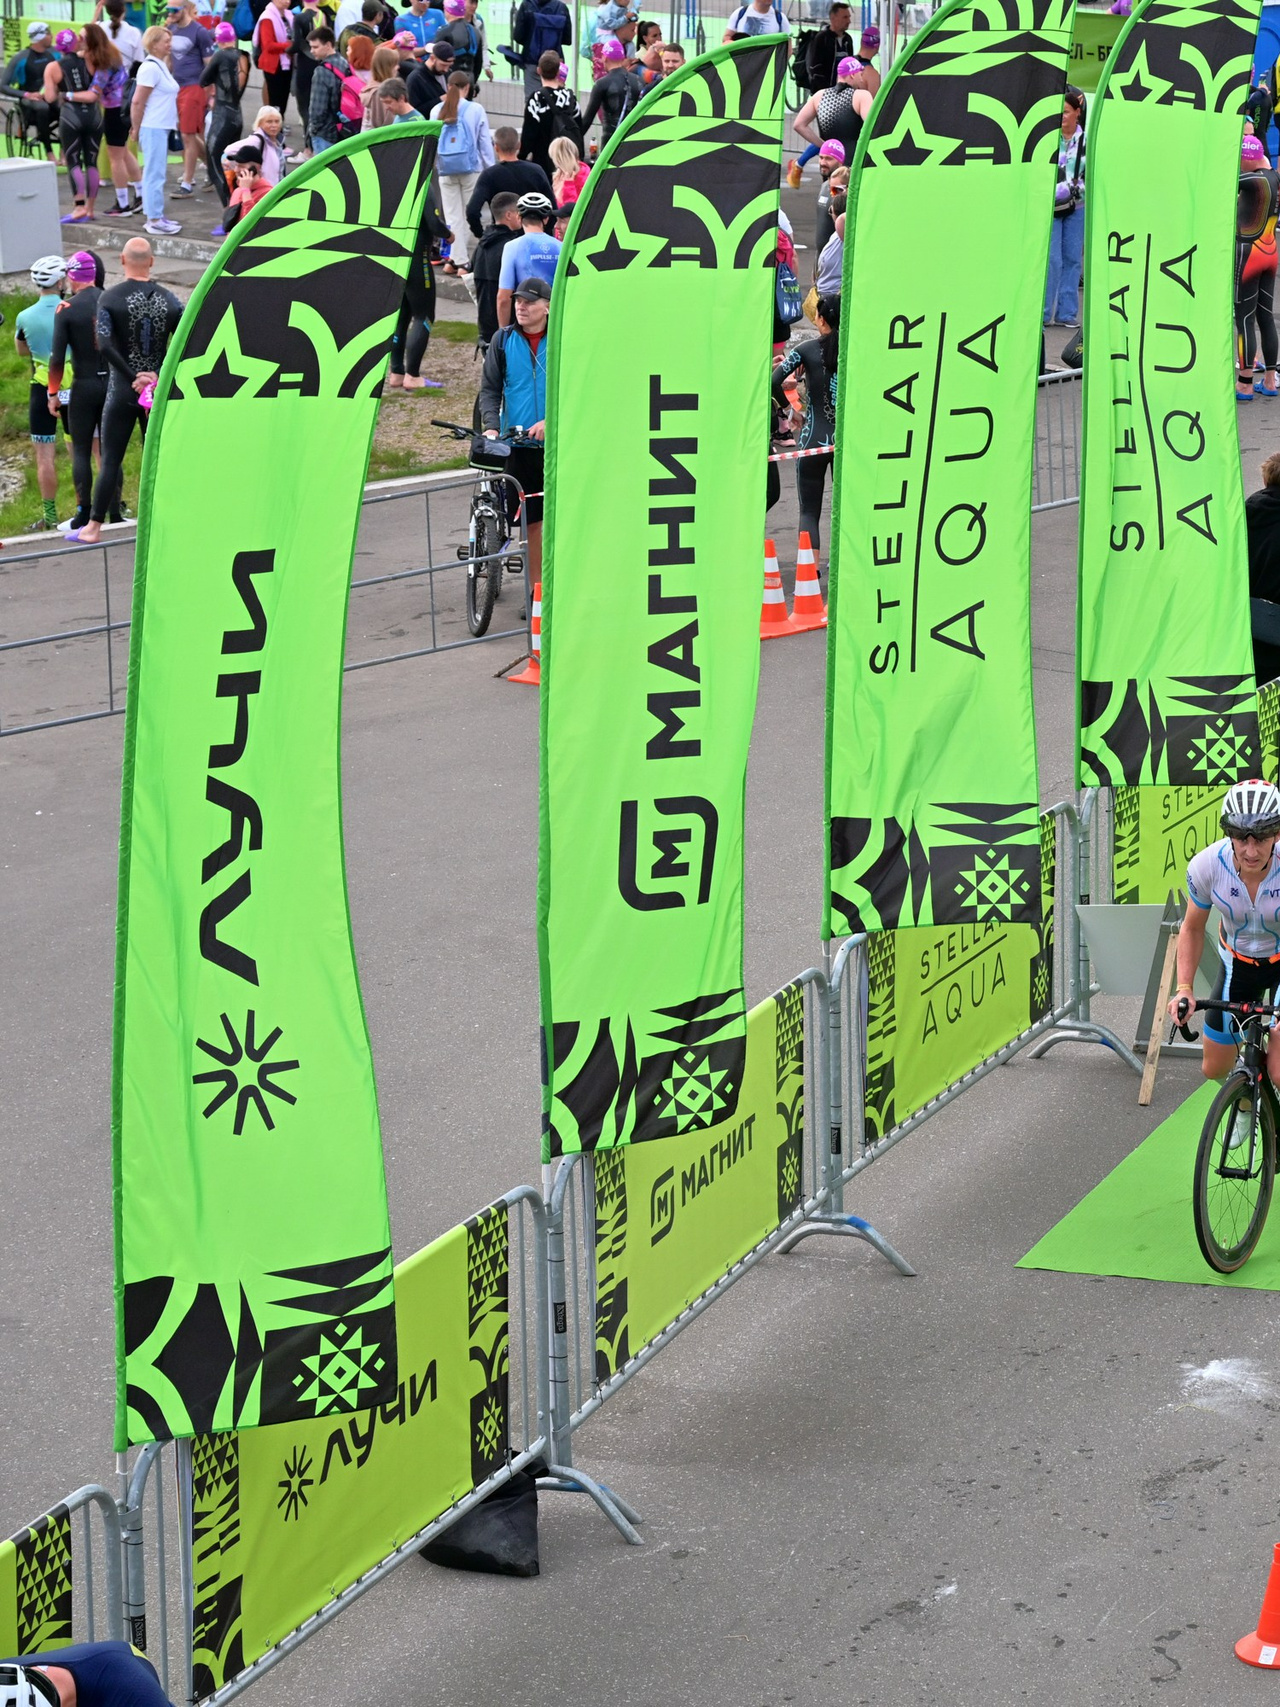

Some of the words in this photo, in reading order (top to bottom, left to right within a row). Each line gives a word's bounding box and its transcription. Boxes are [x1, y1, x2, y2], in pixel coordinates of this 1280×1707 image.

[1242, 141, 1260, 151] aier
[869, 313, 926, 675] STELLAR
[930, 313, 1007, 662] AQUA
[1107, 231, 1145, 552] STELLAR
[1154, 243, 1218, 546] AQUA
[646, 374, 702, 761] МАГНИТ
[199, 548, 276, 987] ЛУЧИ
[1162, 810, 1218, 878] AQU
[920, 921, 1002, 980] STELLA
[921, 952, 1007, 1045] AQUA
[681, 1113, 756, 1208] МАГНИТ
[319, 1359, 438, 1486] ЛУЧИ
